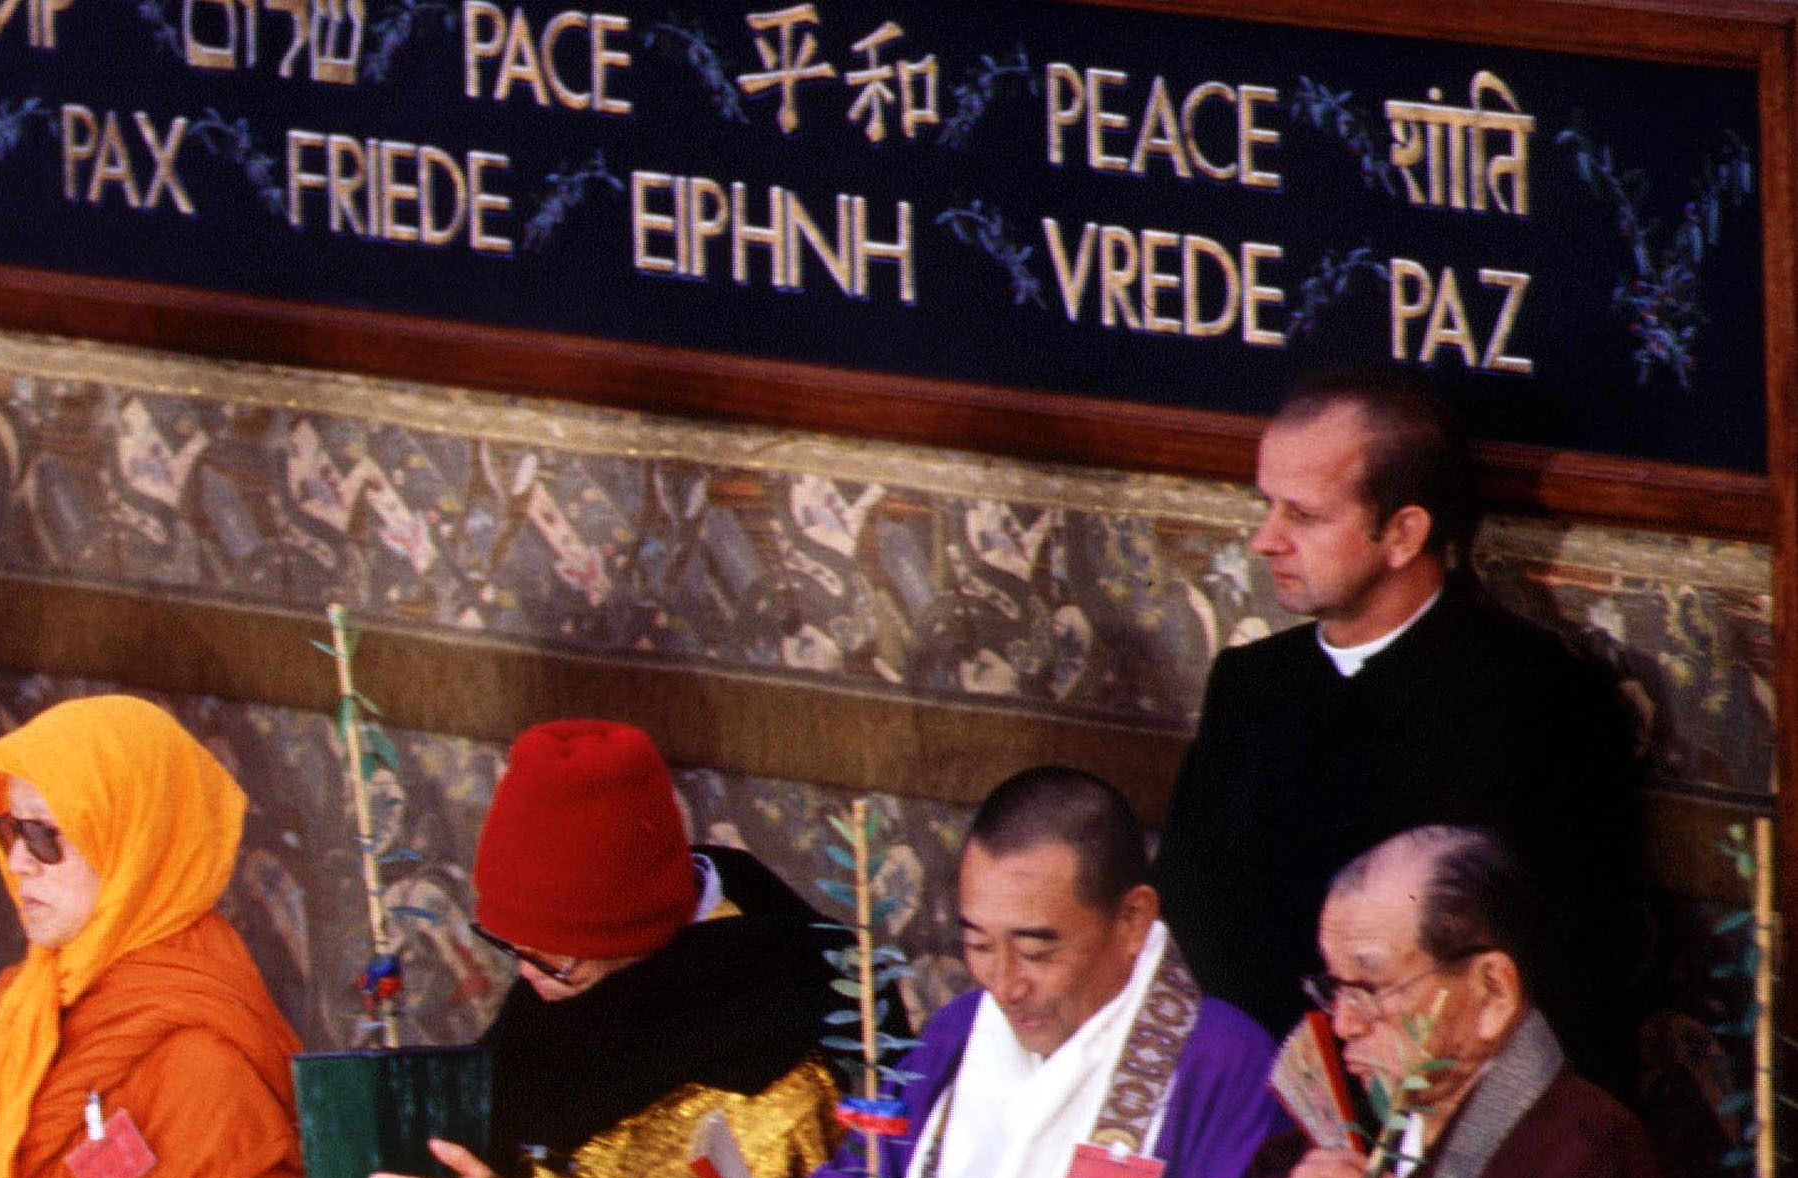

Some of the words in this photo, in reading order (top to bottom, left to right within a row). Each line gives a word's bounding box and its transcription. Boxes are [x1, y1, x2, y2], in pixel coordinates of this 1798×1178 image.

[463, 0, 633, 115] PACE
[736, 4, 938, 143] 平和
[61, 103, 195, 215] PAX
[1046, 62, 1281, 188] PEACE
[1383, 69, 1537, 216] शांति
[287, 129, 512, 252] FRIEDE
[1042, 217, 1285, 347] VREDE
[1389, 257, 1534, 375] PAZ
